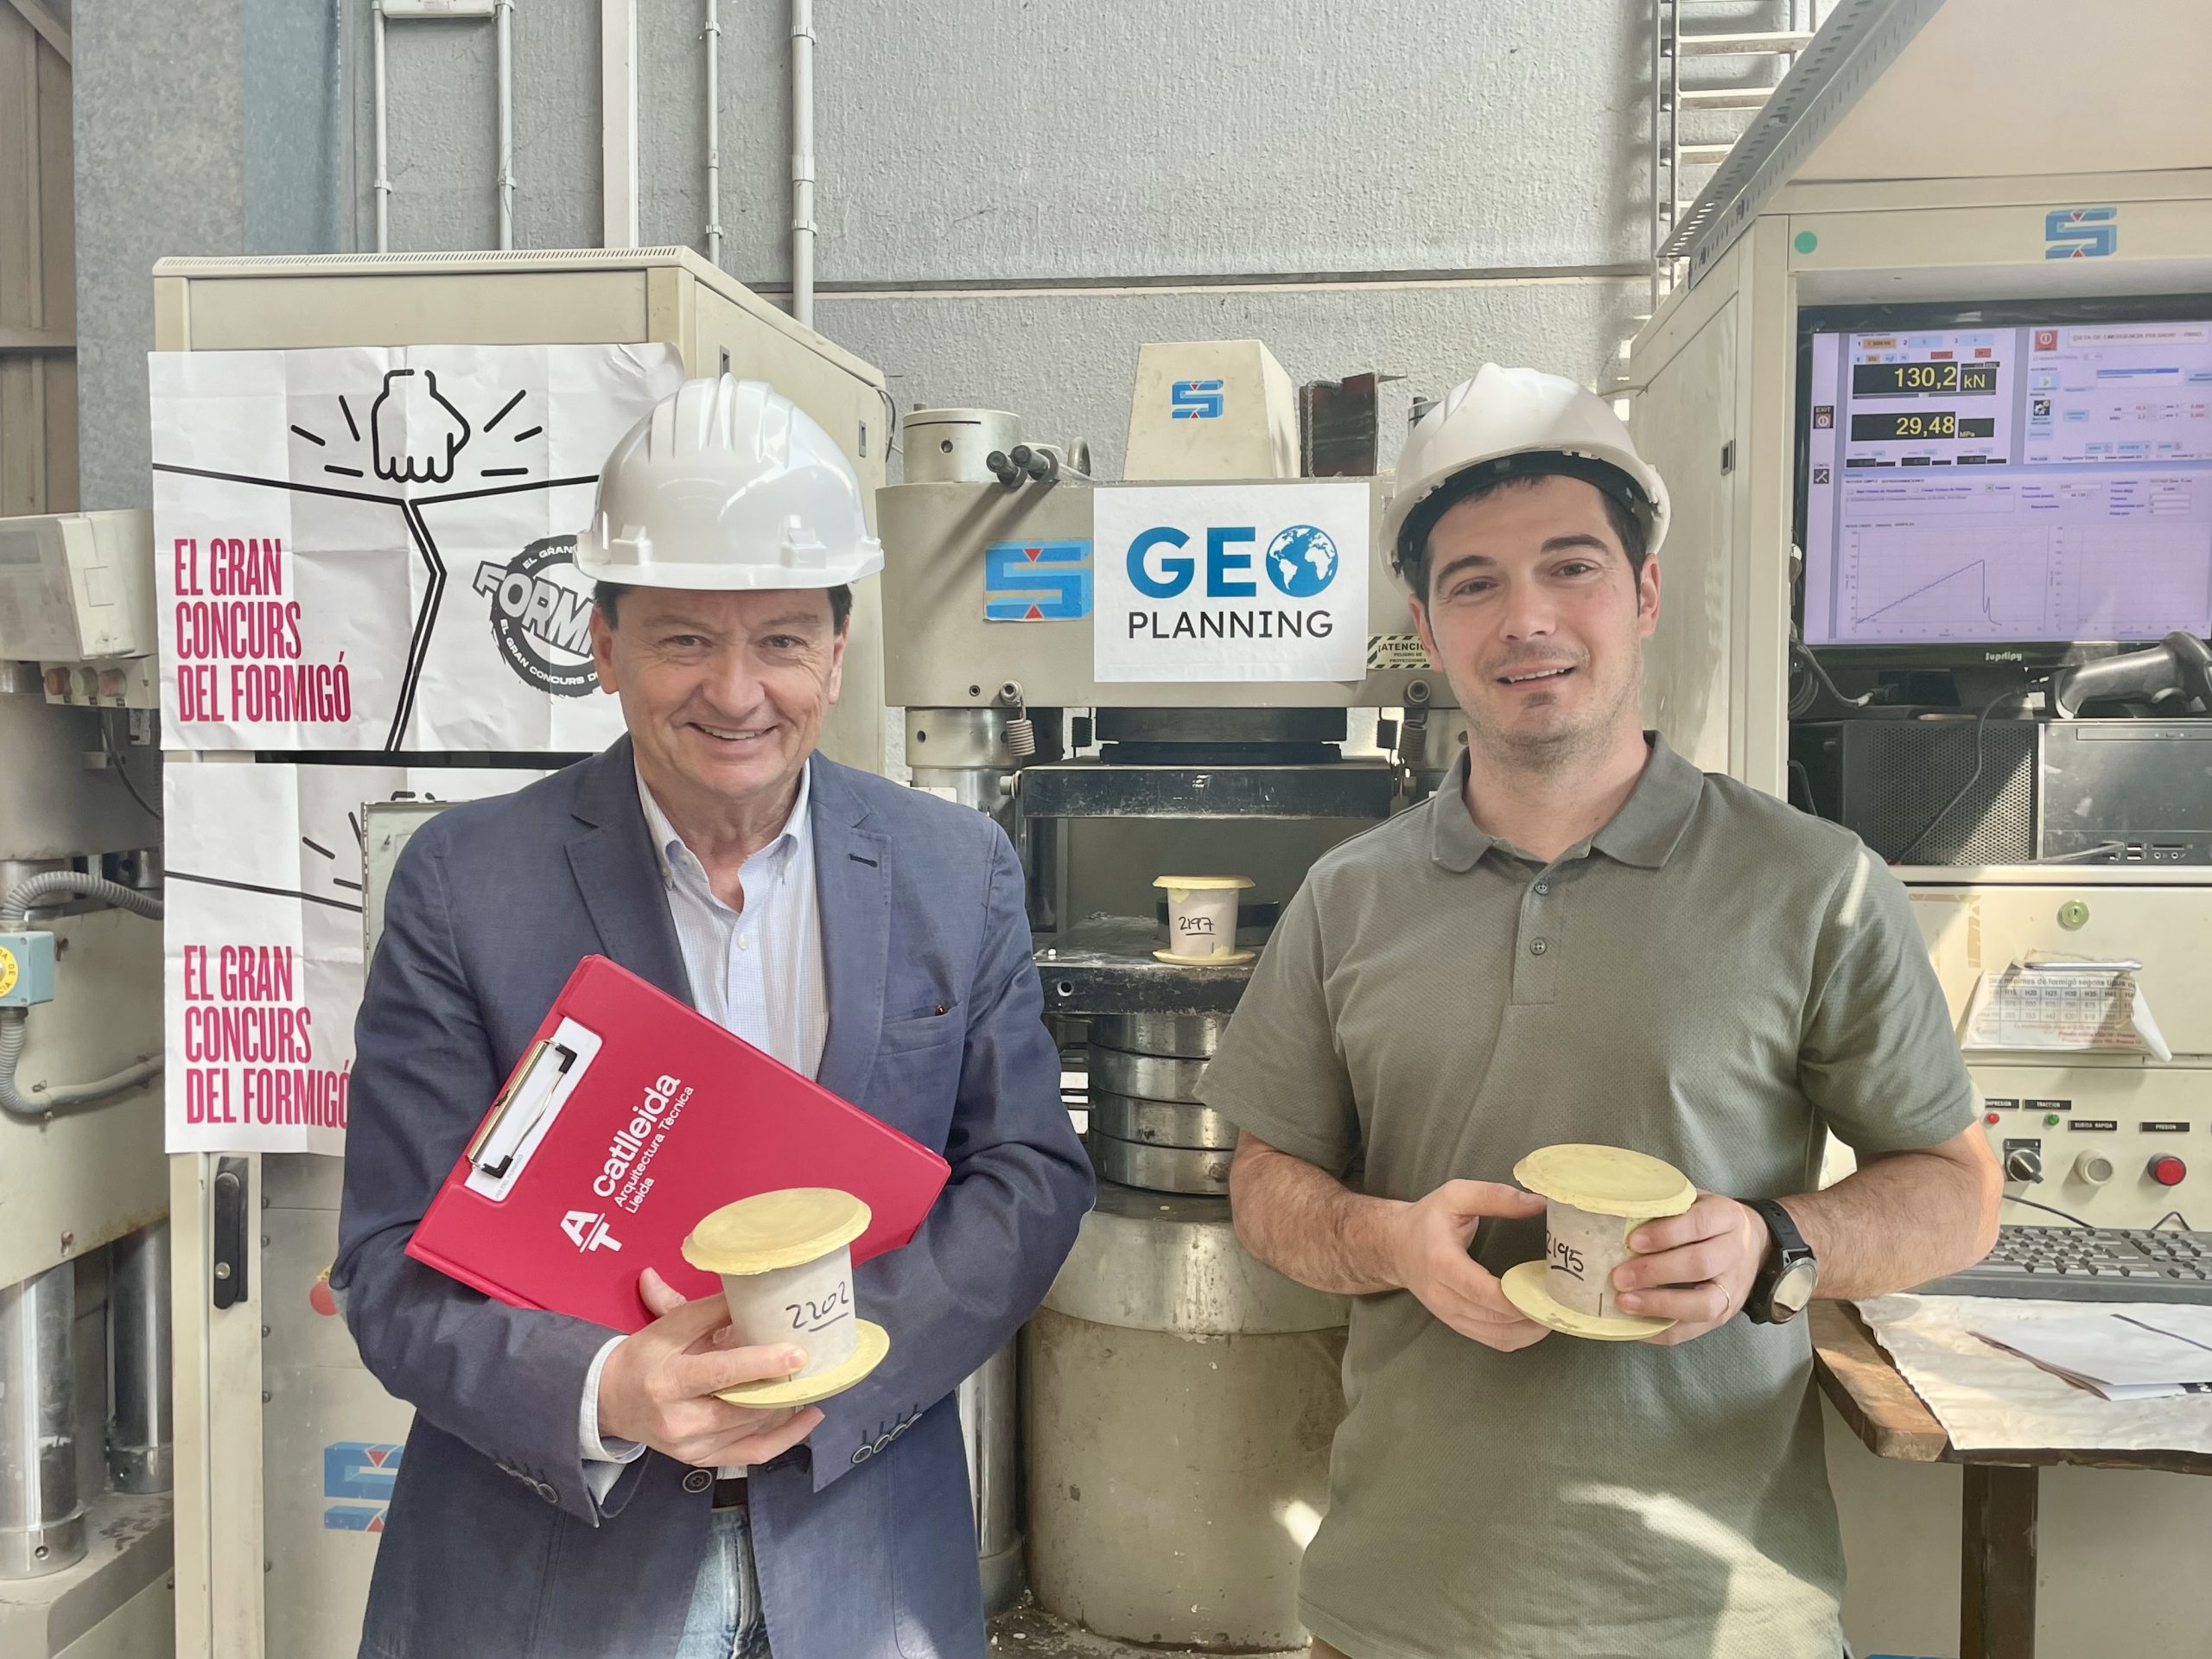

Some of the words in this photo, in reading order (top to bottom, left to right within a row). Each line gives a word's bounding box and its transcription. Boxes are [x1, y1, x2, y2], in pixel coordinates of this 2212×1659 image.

[1894, 366, 1957, 390] 130,2
[1964, 374, 1986, 388] kN
[1896, 416, 1955, 437] 29,48
[175, 538, 206, 596] EL
[209, 537, 282, 596] GRAN
[523, 557, 538, 570] EL
[1126, 524, 1338, 598] GEO
[176, 601, 301, 660] CONCURS
[500, 619, 509, 635] EL
[506, 637, 529, 669] GRAN
[529, 666, 585, 685] CONCURS
[1129, 610, 1333, 639] PLANNING
[1378, 643, 1425, 652] ¡ATENCI
[177, 664, 225, 722] DEL
[231, 652, 352, 722] FORMIGÓ
[1179, 916, 1214, 932] 2197
[184, 945, 213, 1001] EL
[220, 944, 292, 1001] GRAN
[184, 1006, 312, 1064] CONCURS
[186, 1069, 237, 1124] DEL
[243, 1059, 350, 1129] FORMIGÓ
[593, 1073, 681, 1198] catlleida
[613, 1132, 664, 1208] Arquitectura
[658, 1085, 694, 1131] Tècnica
[626, 1177, 655, 1214] Lleida
[786, 1281, 849, 1329] 2202
